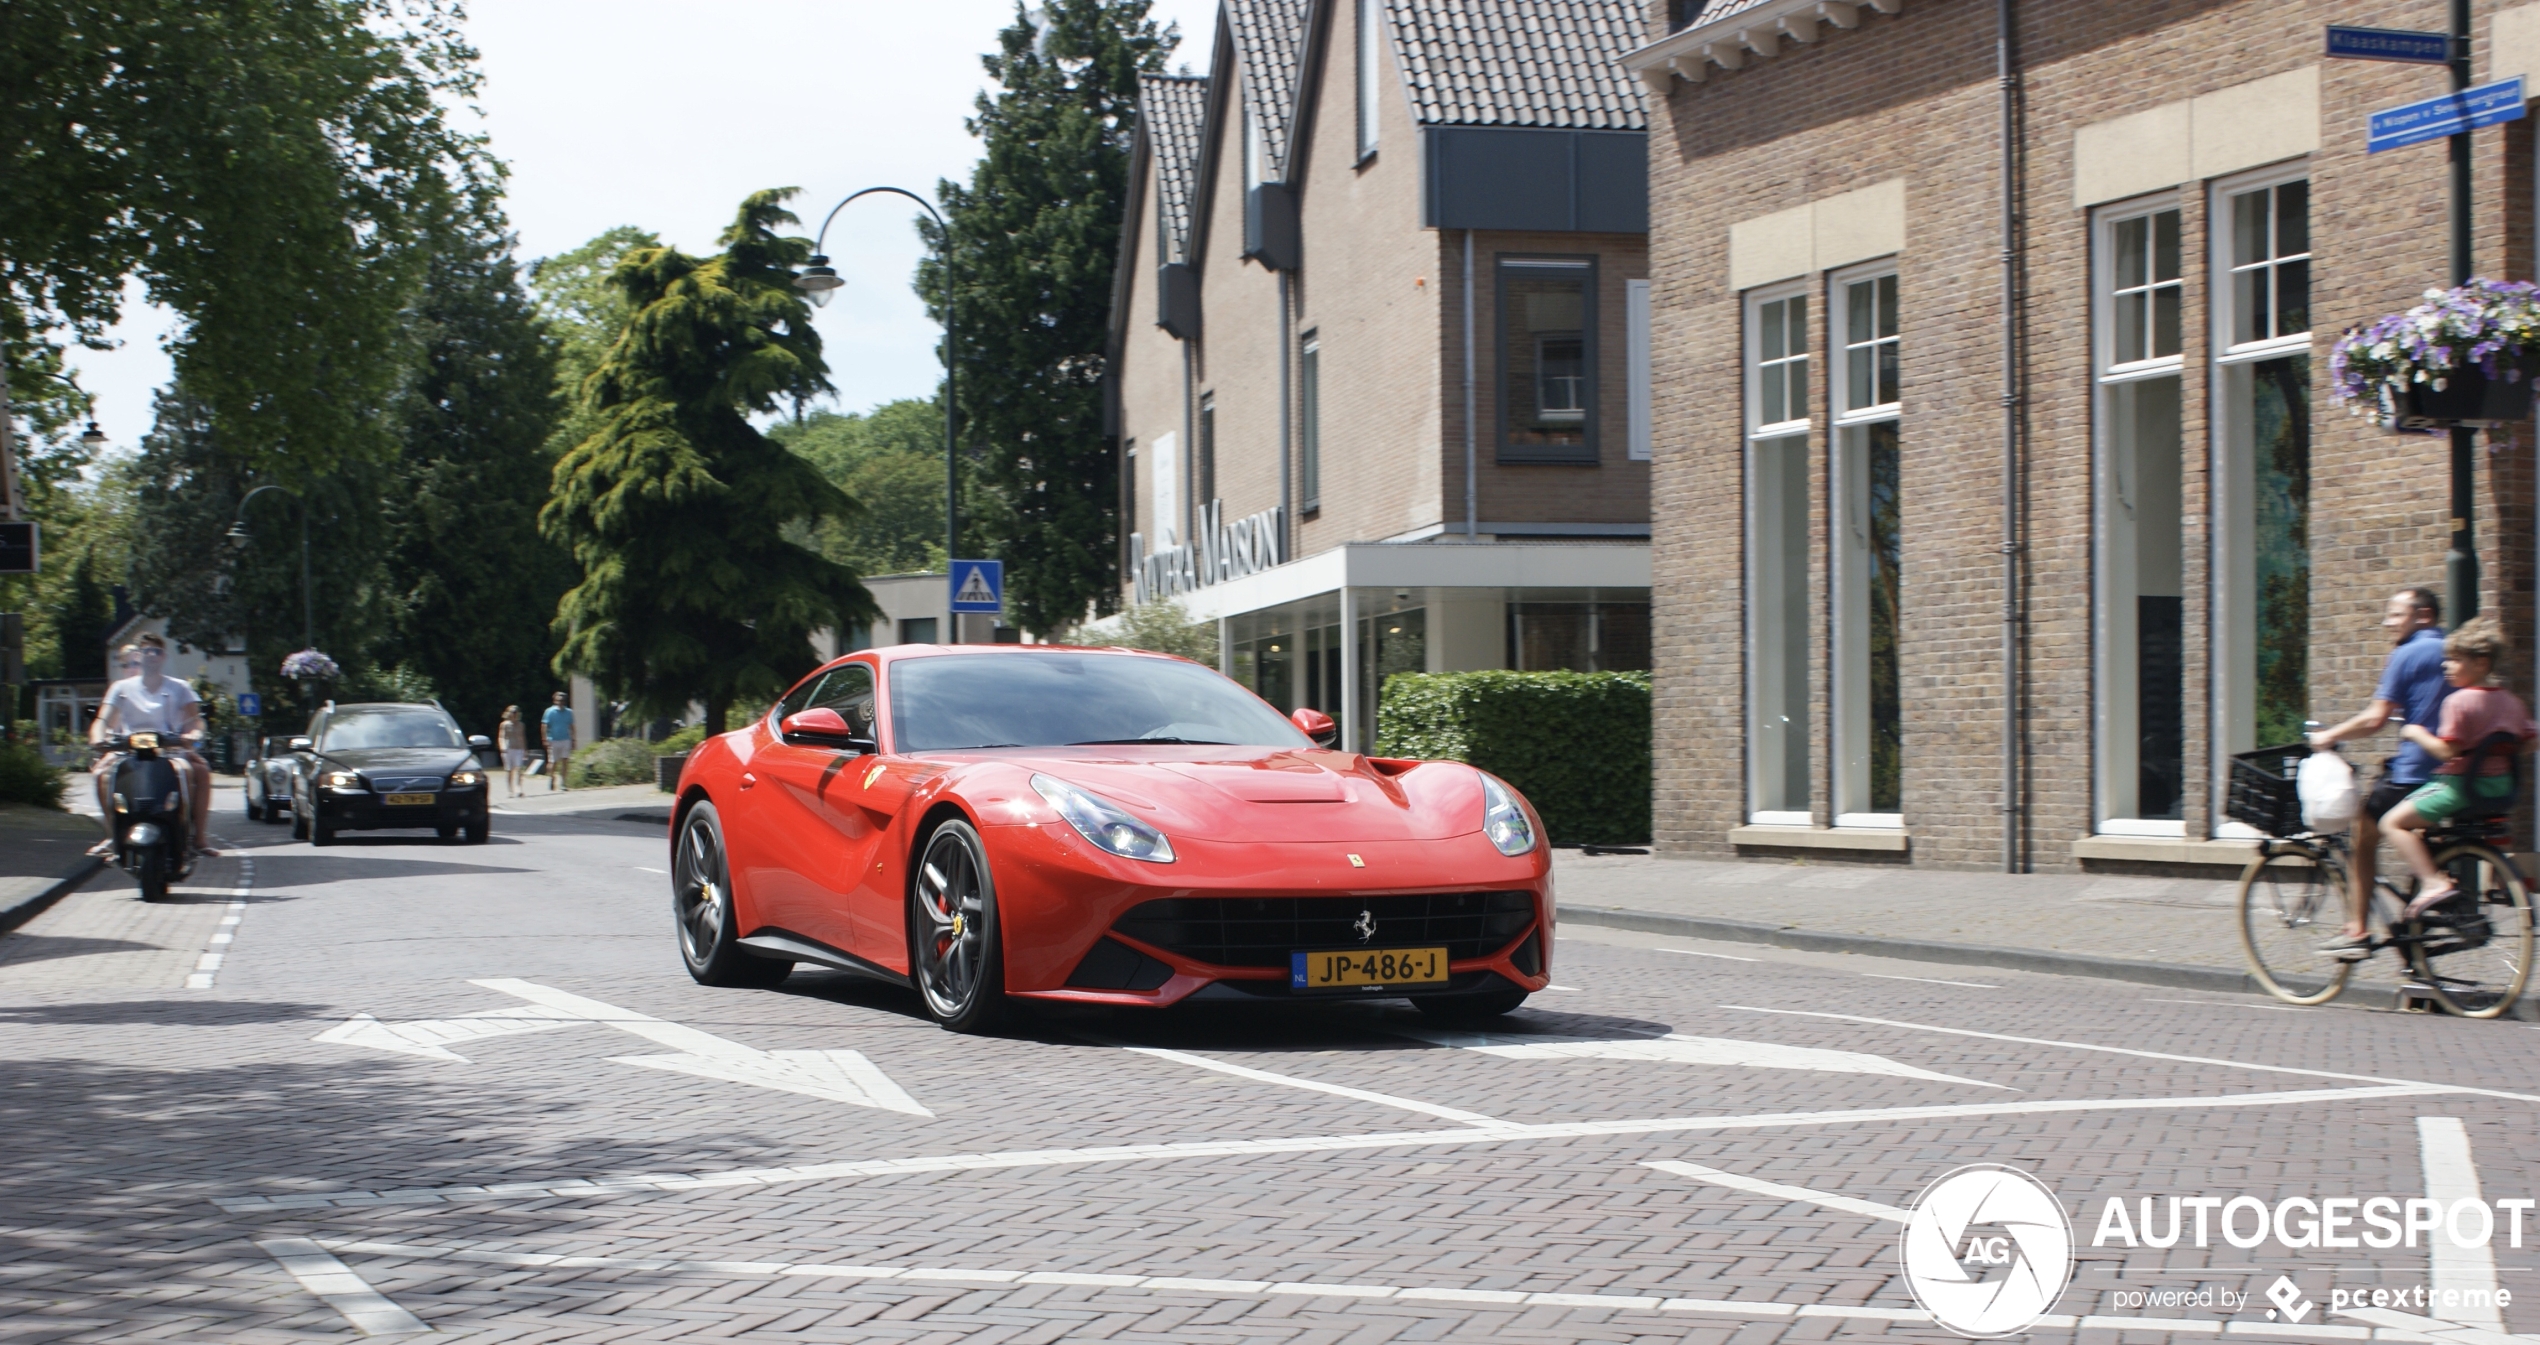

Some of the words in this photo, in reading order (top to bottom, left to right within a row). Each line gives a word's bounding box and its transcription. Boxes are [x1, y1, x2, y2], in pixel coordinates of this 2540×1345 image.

[2332, 33, 2442, 55] Klaaskampen
[1198, 498, 1281, 587] MAISON
[1294, 974, 1306, 982] NL
[1320, 953, 1436, 982] JP-486-J
